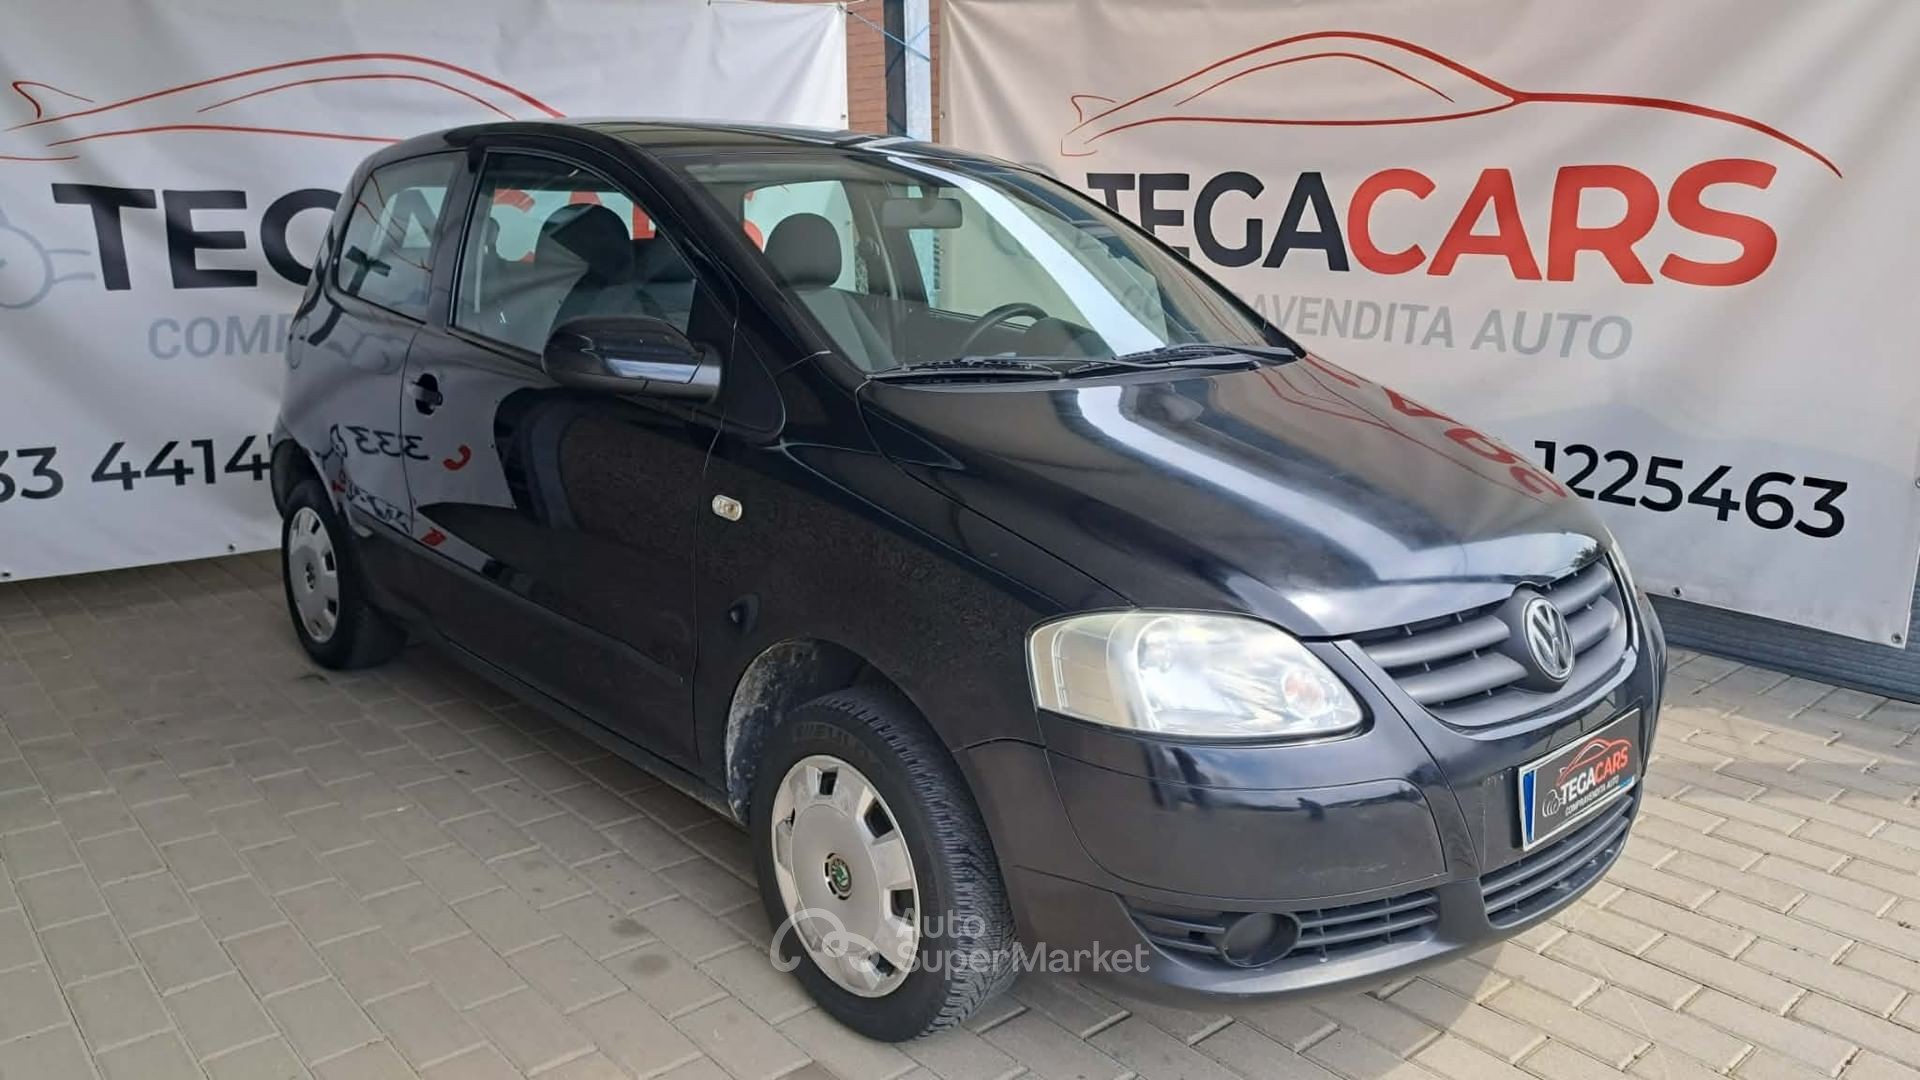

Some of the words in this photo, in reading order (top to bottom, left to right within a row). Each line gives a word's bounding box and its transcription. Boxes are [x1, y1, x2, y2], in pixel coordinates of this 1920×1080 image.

[1086, 157, 1778, 287] TEGACARS
[1470, 308, 1633, 361] AUTO
[91, 434, 274, 491] 4414
[1534, 440, 1849, 538] 1225463
[1560, 746, 1629, 805] TEGACARS
